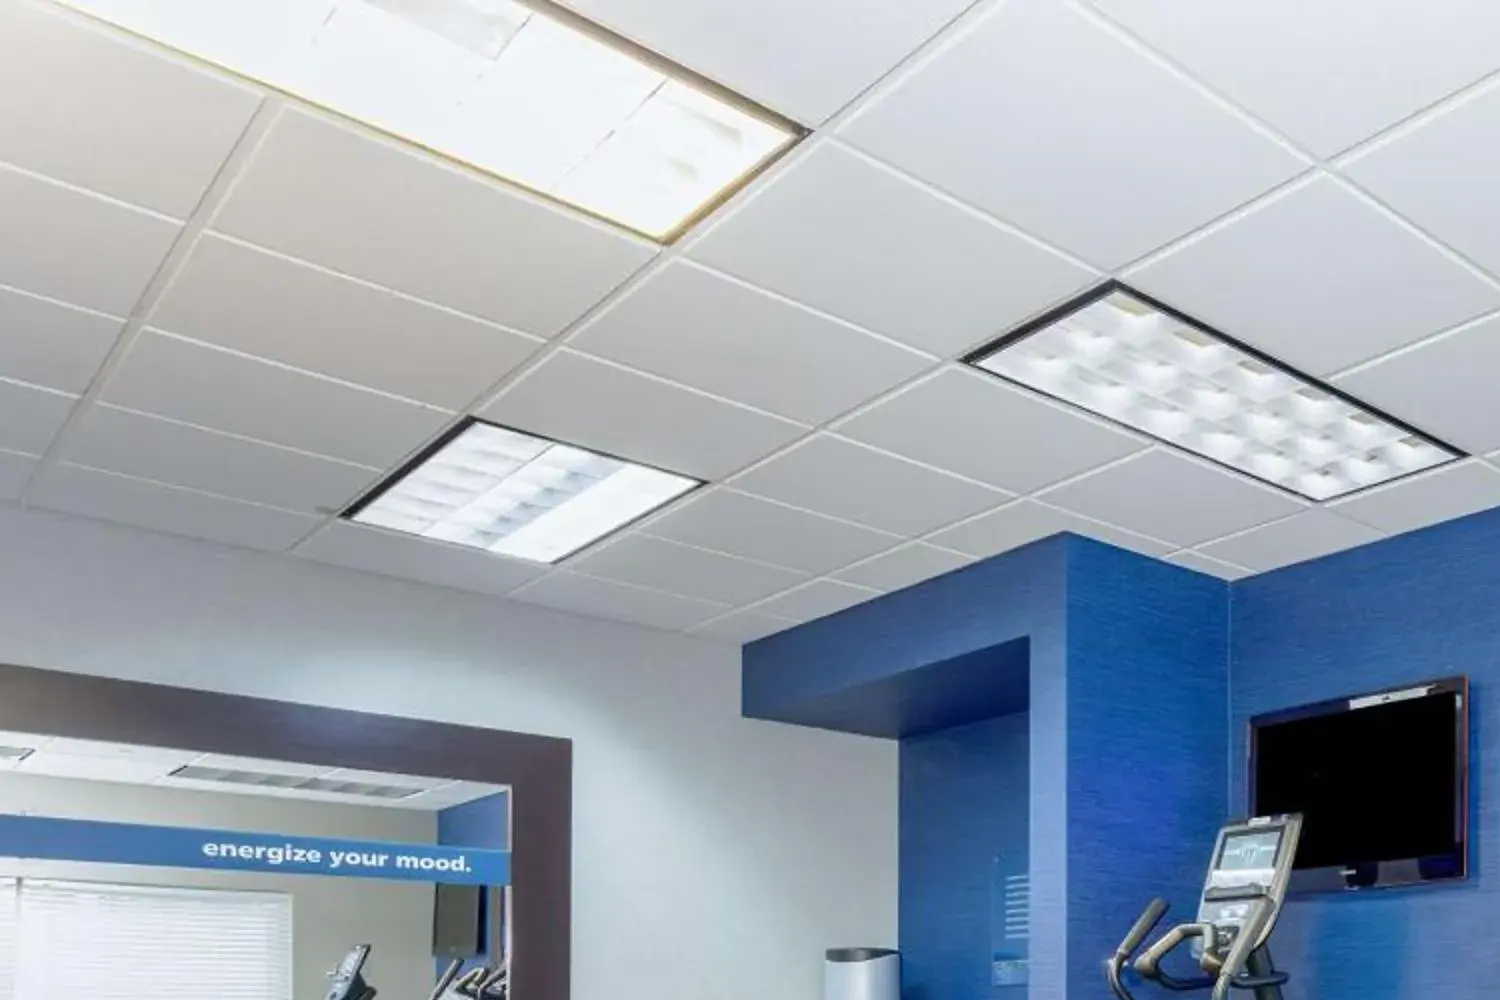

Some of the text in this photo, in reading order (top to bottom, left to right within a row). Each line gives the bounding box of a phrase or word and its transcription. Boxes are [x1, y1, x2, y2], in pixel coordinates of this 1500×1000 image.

[202, 841, 472, 873] energize your mood.
